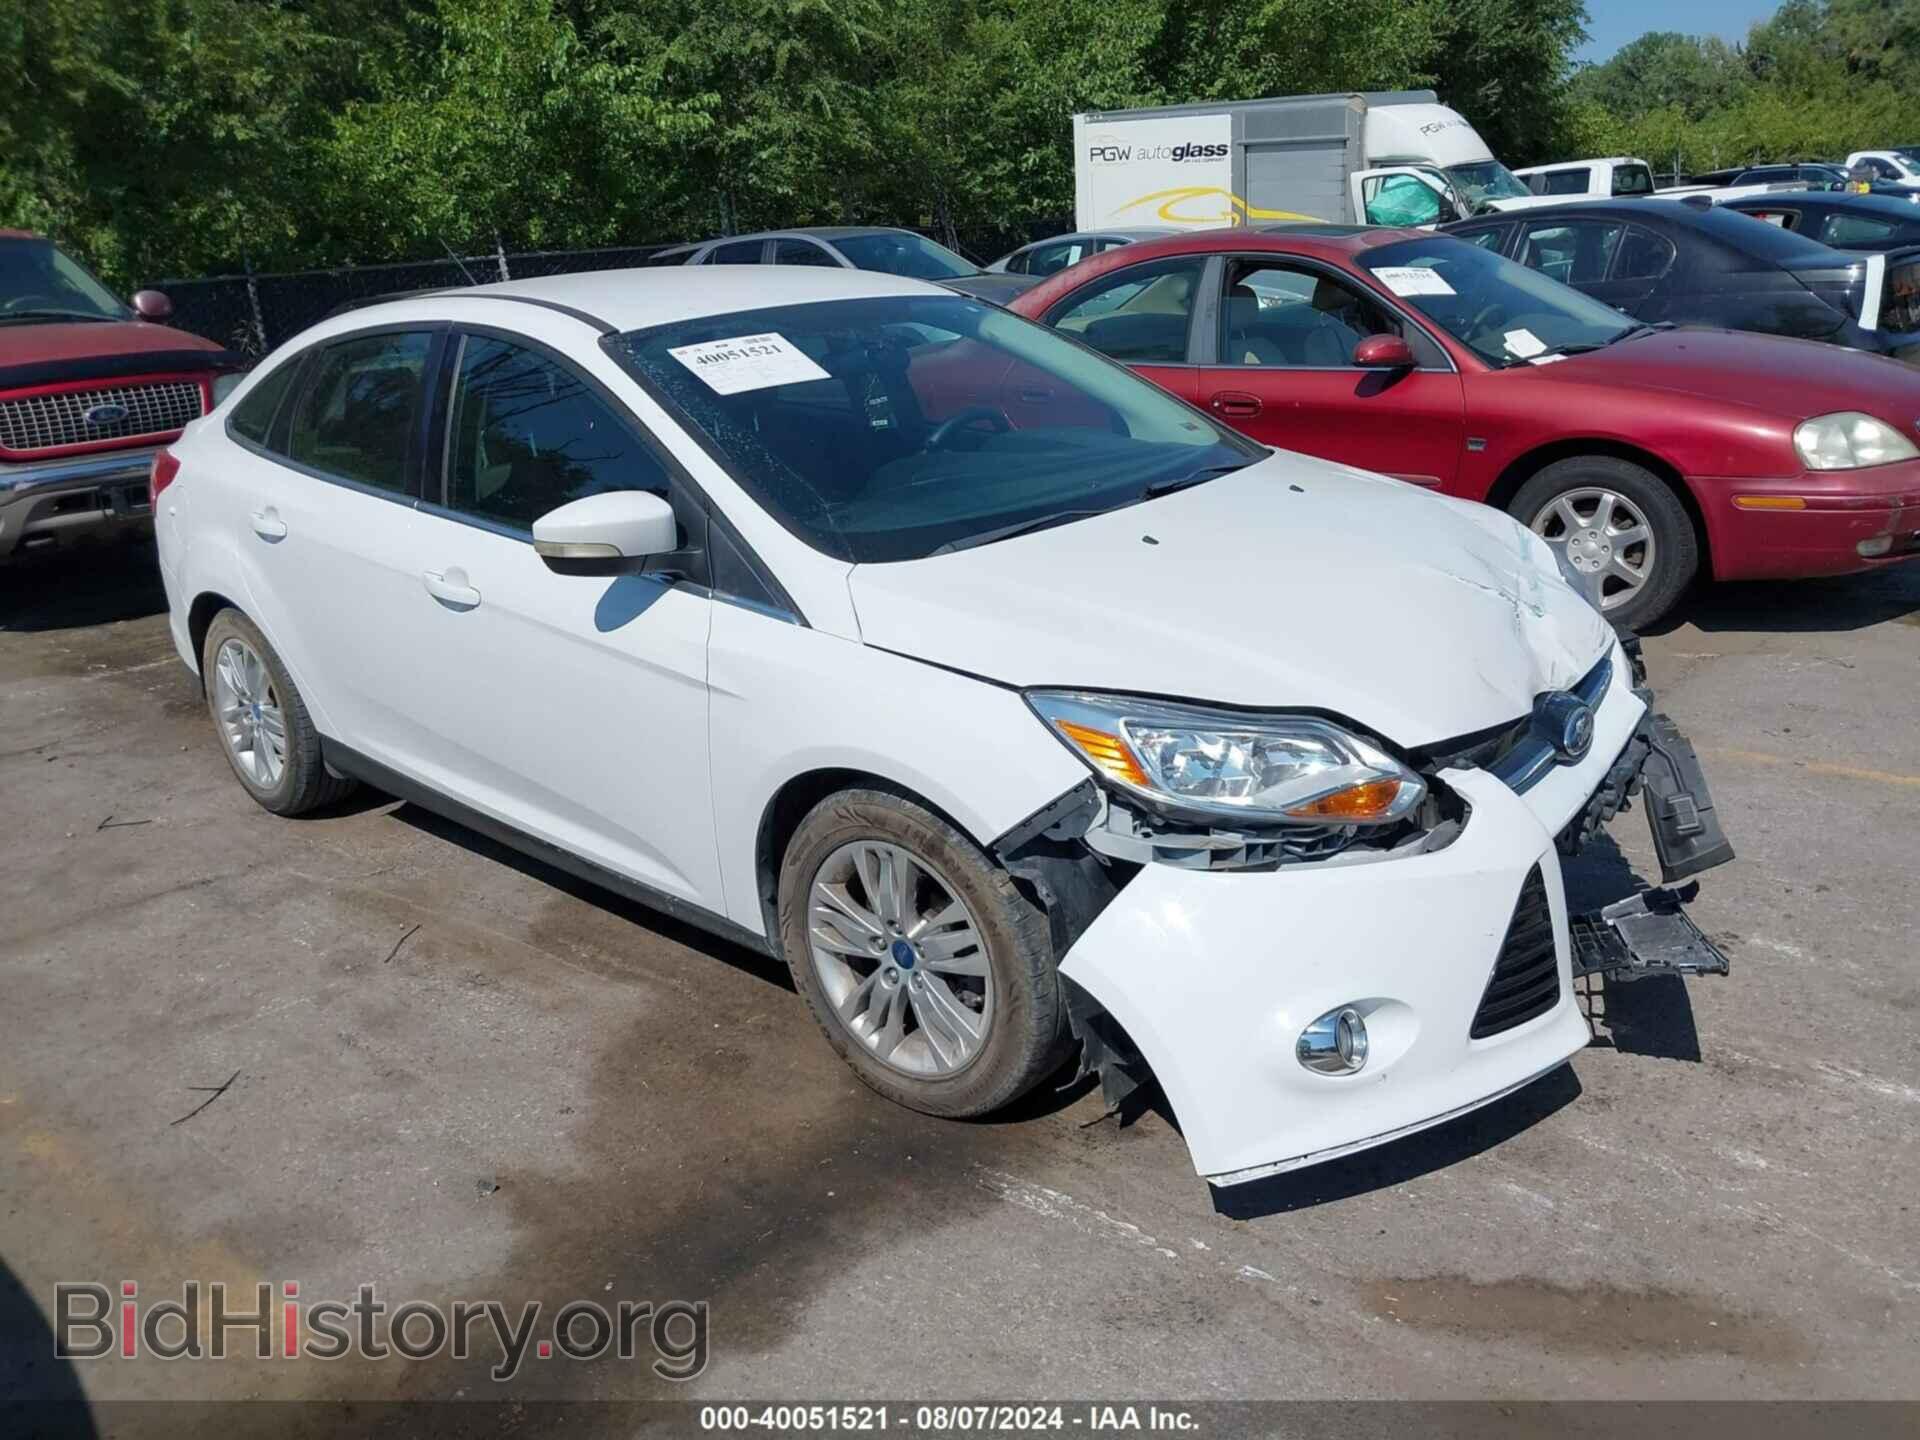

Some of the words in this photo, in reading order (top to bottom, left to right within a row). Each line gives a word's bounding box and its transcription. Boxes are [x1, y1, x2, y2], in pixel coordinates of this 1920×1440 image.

[1090, 145, 1132, 161] PGW
[1137, 142, 1228, 162] autoglass
[696, 344, 782, 365] 40051521
